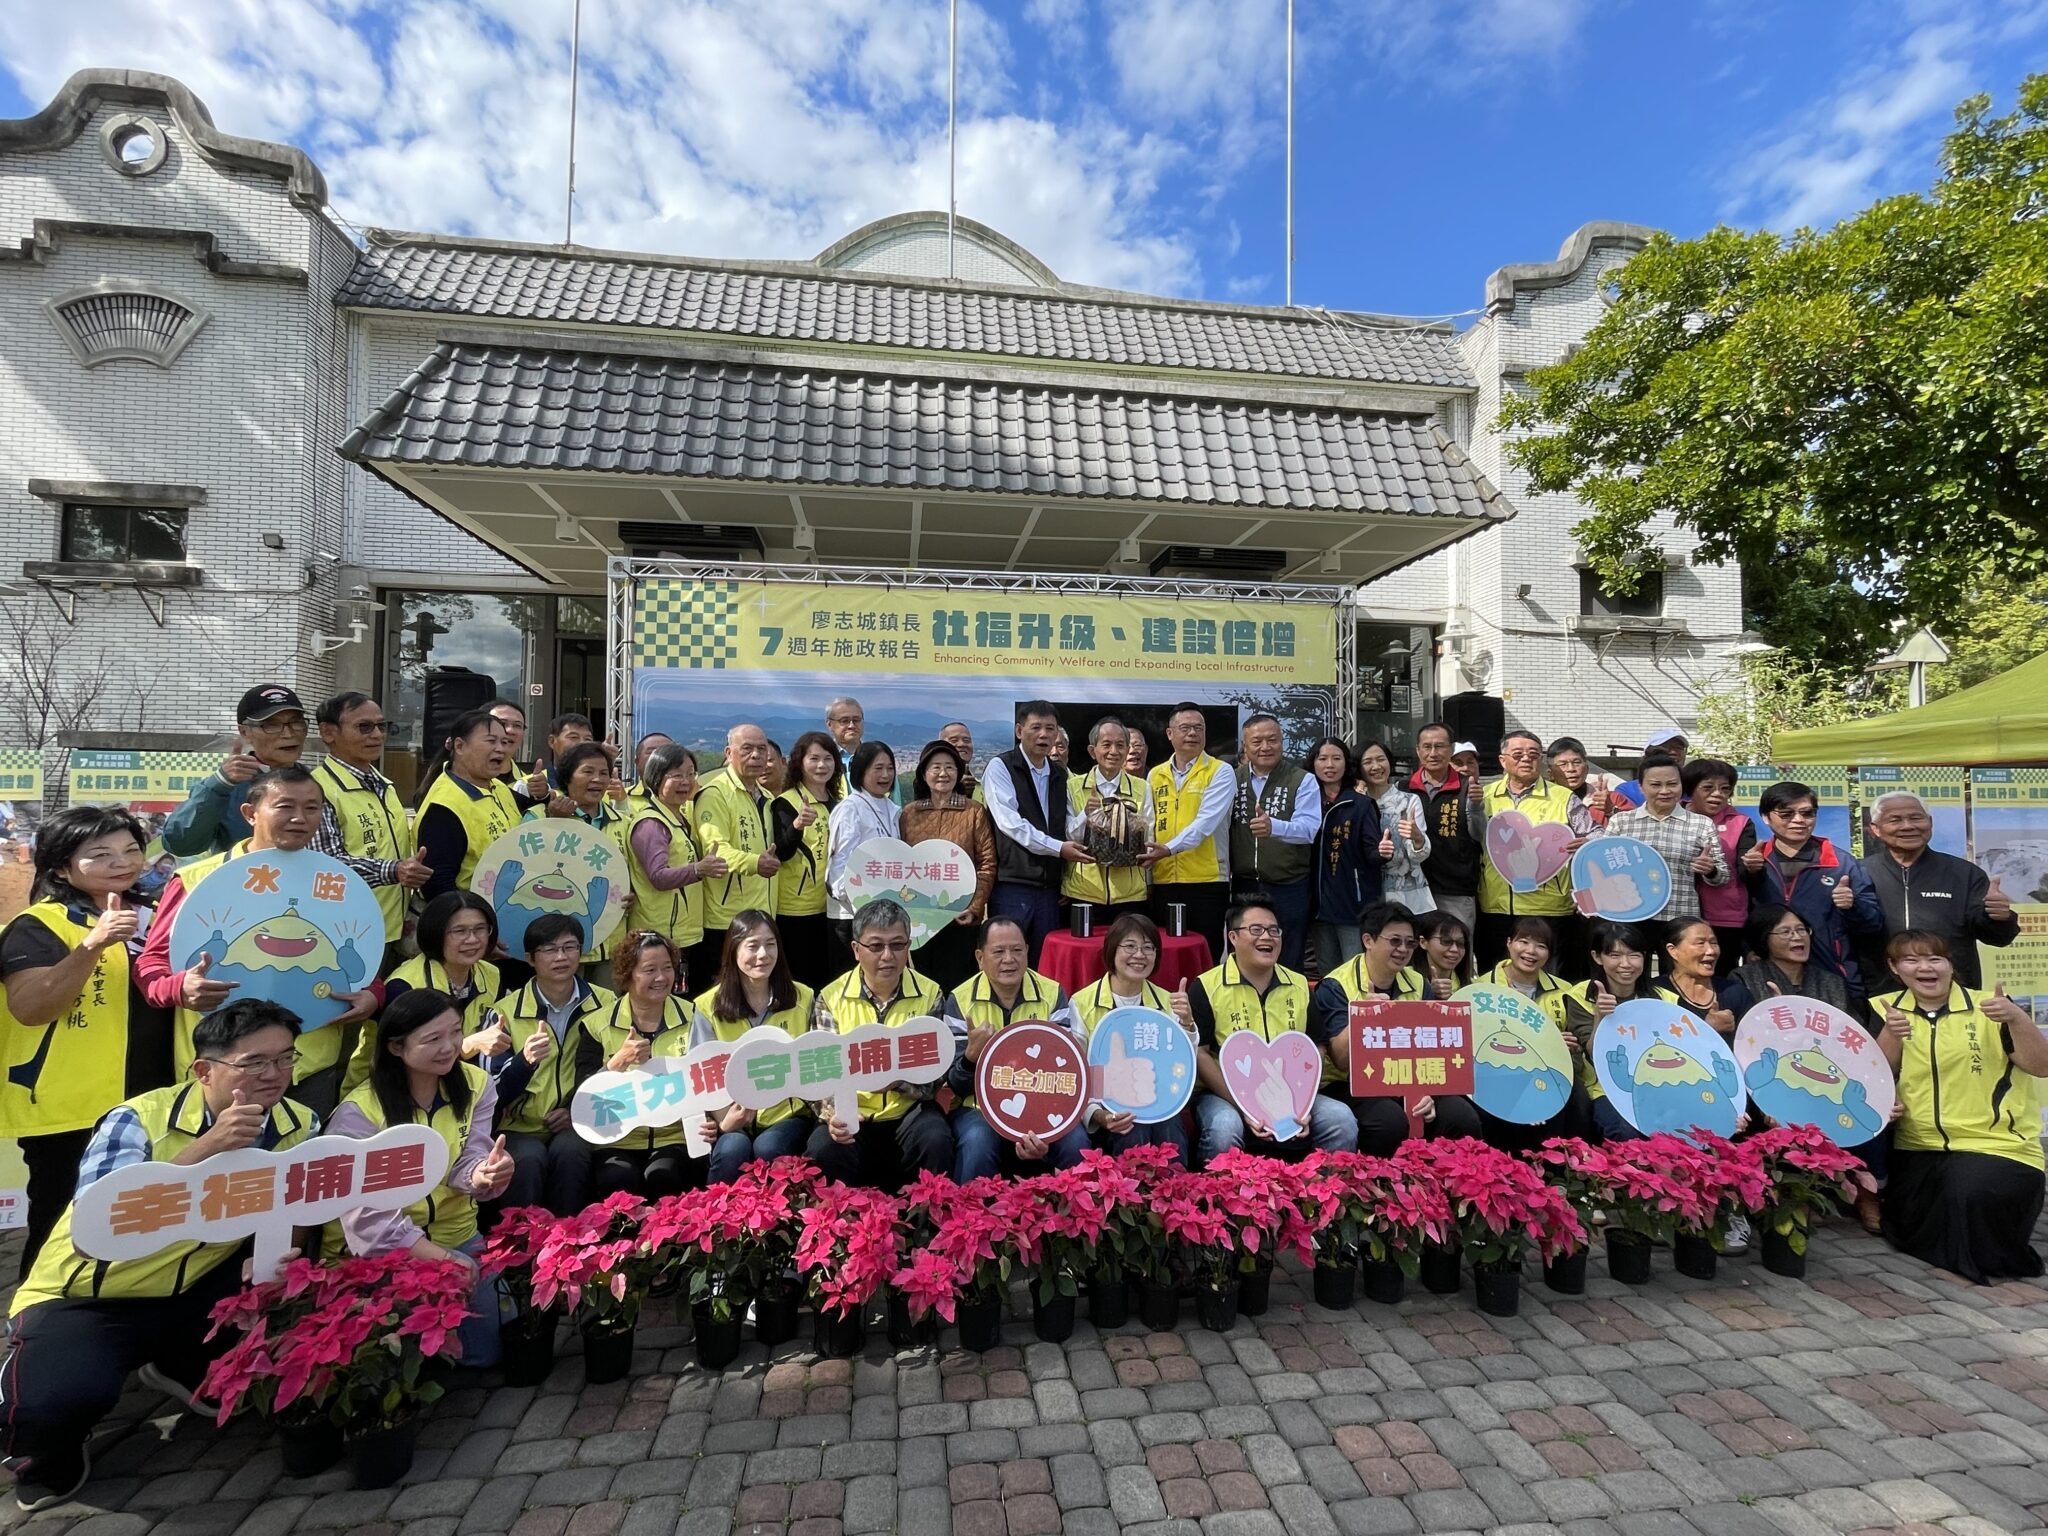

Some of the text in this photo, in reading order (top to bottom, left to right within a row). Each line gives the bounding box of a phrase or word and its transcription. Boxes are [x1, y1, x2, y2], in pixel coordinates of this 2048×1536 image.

[811, 610, 921, 633] 廖志城鎮長
[932, 609, 1296, 657] 社福升級、建設倍增
[934, 652, 1295, 673] Enhancing Community Welfare and Expanding Local Infrastructure
[517, 830, 614, 871] 作伙來
[243, 864, 347, 902] 水啦
[864, 859, 961, 882] 幸福大埔里
[1921, 891, 1952, 899] TAIWAN
[1472, 991, 1546, 1034] 交給我
[1768, 1004, 1868, 1055] 看過來
[1362, 1026, 1464, 1049] 社會福利
[1965, 1022, 1983, 1076] 埔里鎮公所
[746, 1031, 941, 1092] 守護埔里
[1382, 1057, 1447, 1086] 加碼
[990, 1065, 1077, 1097] 禮金加碼
[109, 1143, 425, 1237] 幸福埔里
